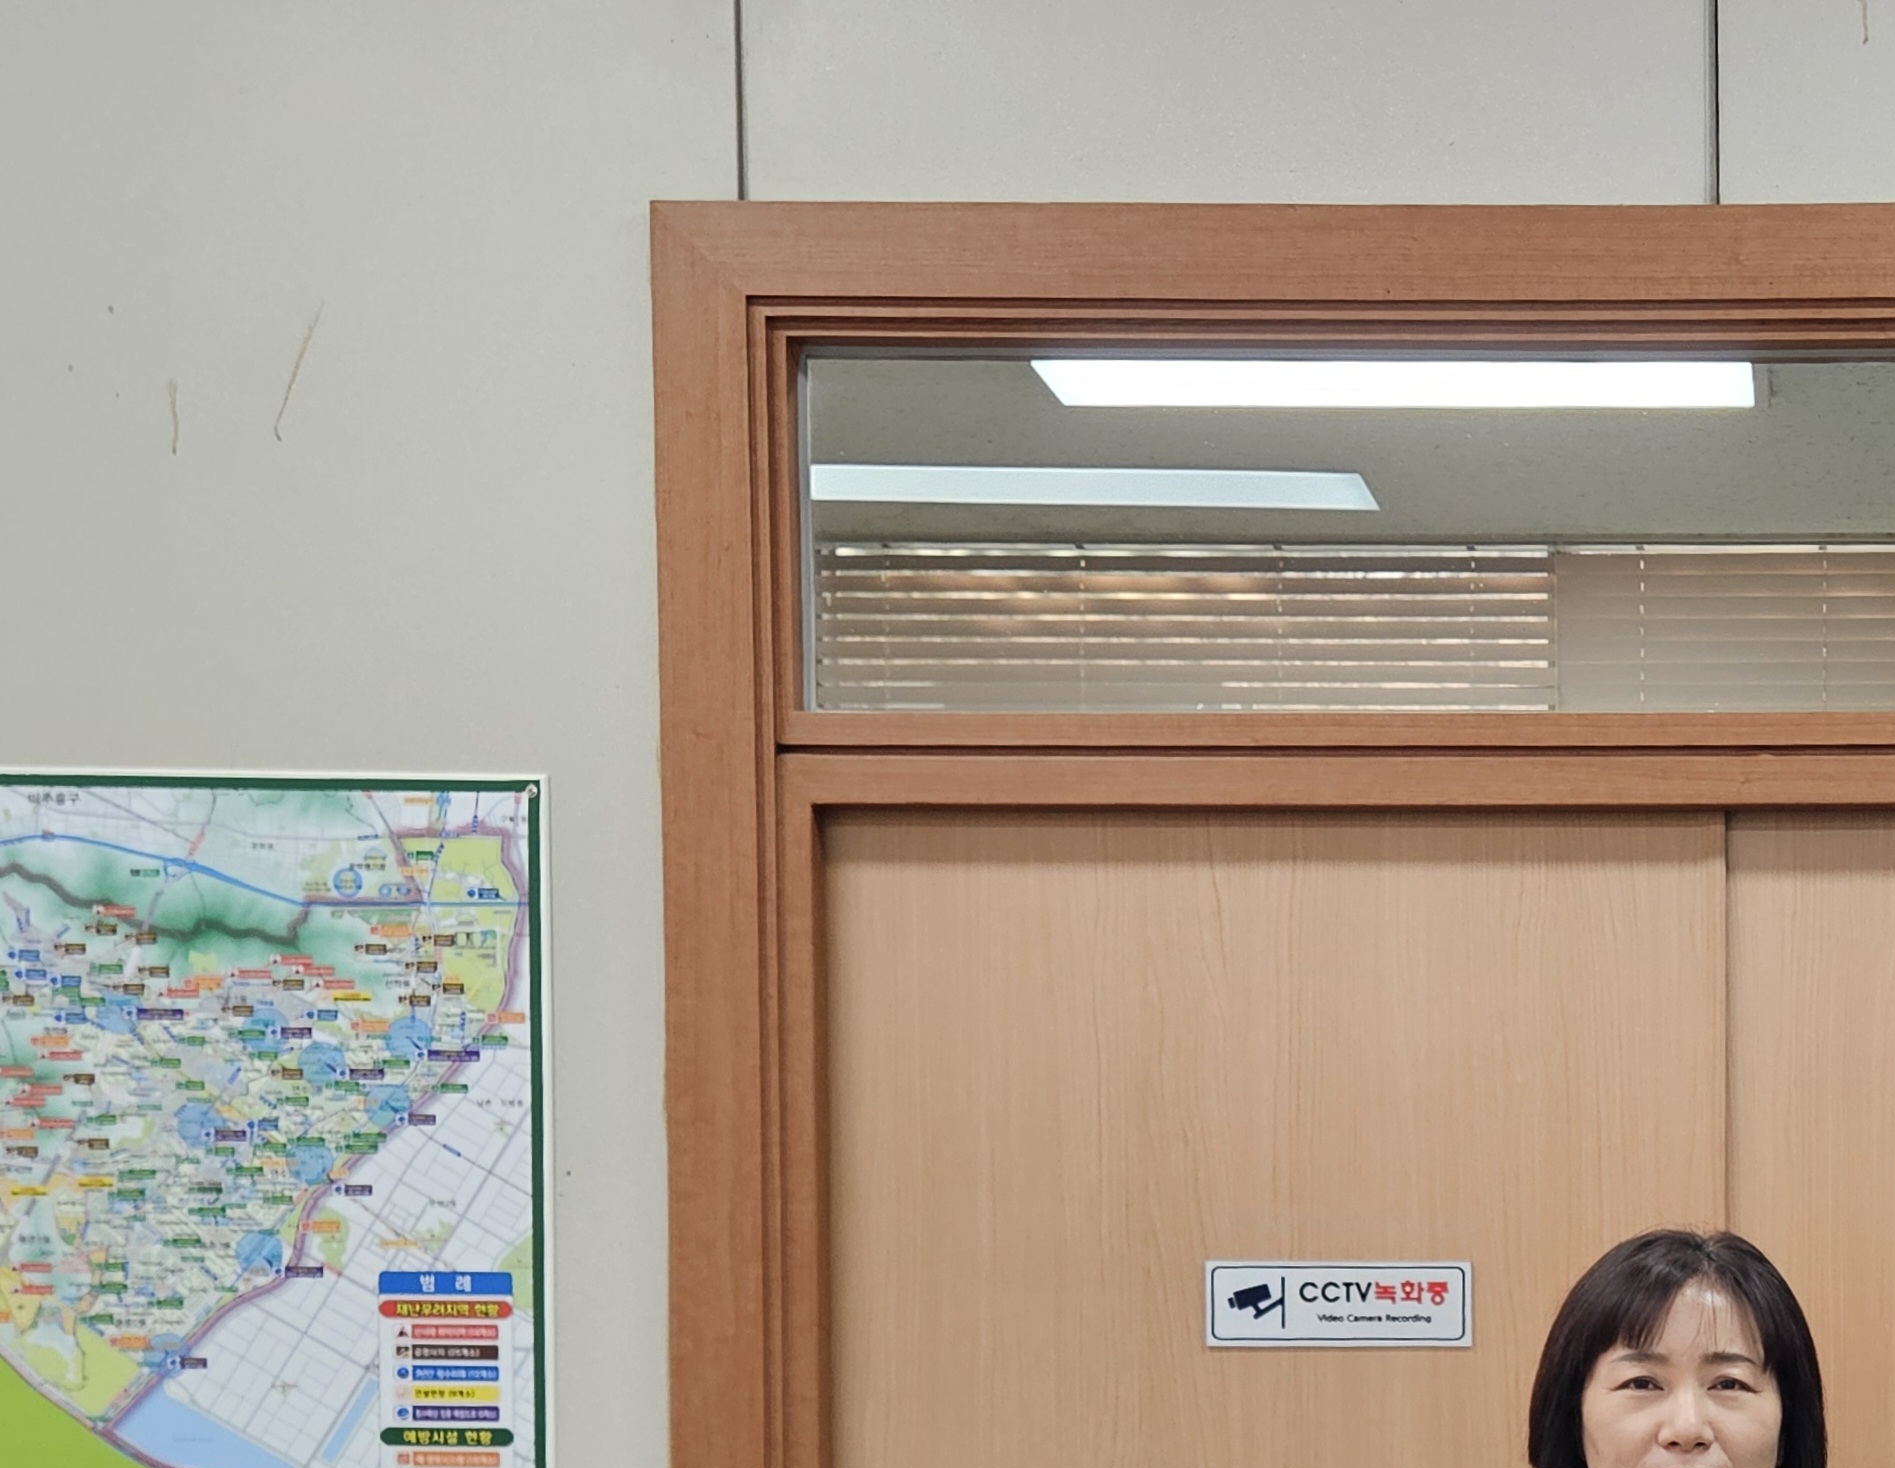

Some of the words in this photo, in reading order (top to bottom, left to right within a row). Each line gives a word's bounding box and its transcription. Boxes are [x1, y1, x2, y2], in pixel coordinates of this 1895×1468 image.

[1316, 1313, 1345, 1323] Video
[1346, 1313, 1383, 1323] Camera
[1385, 1313, 1432, 1324] Recording
